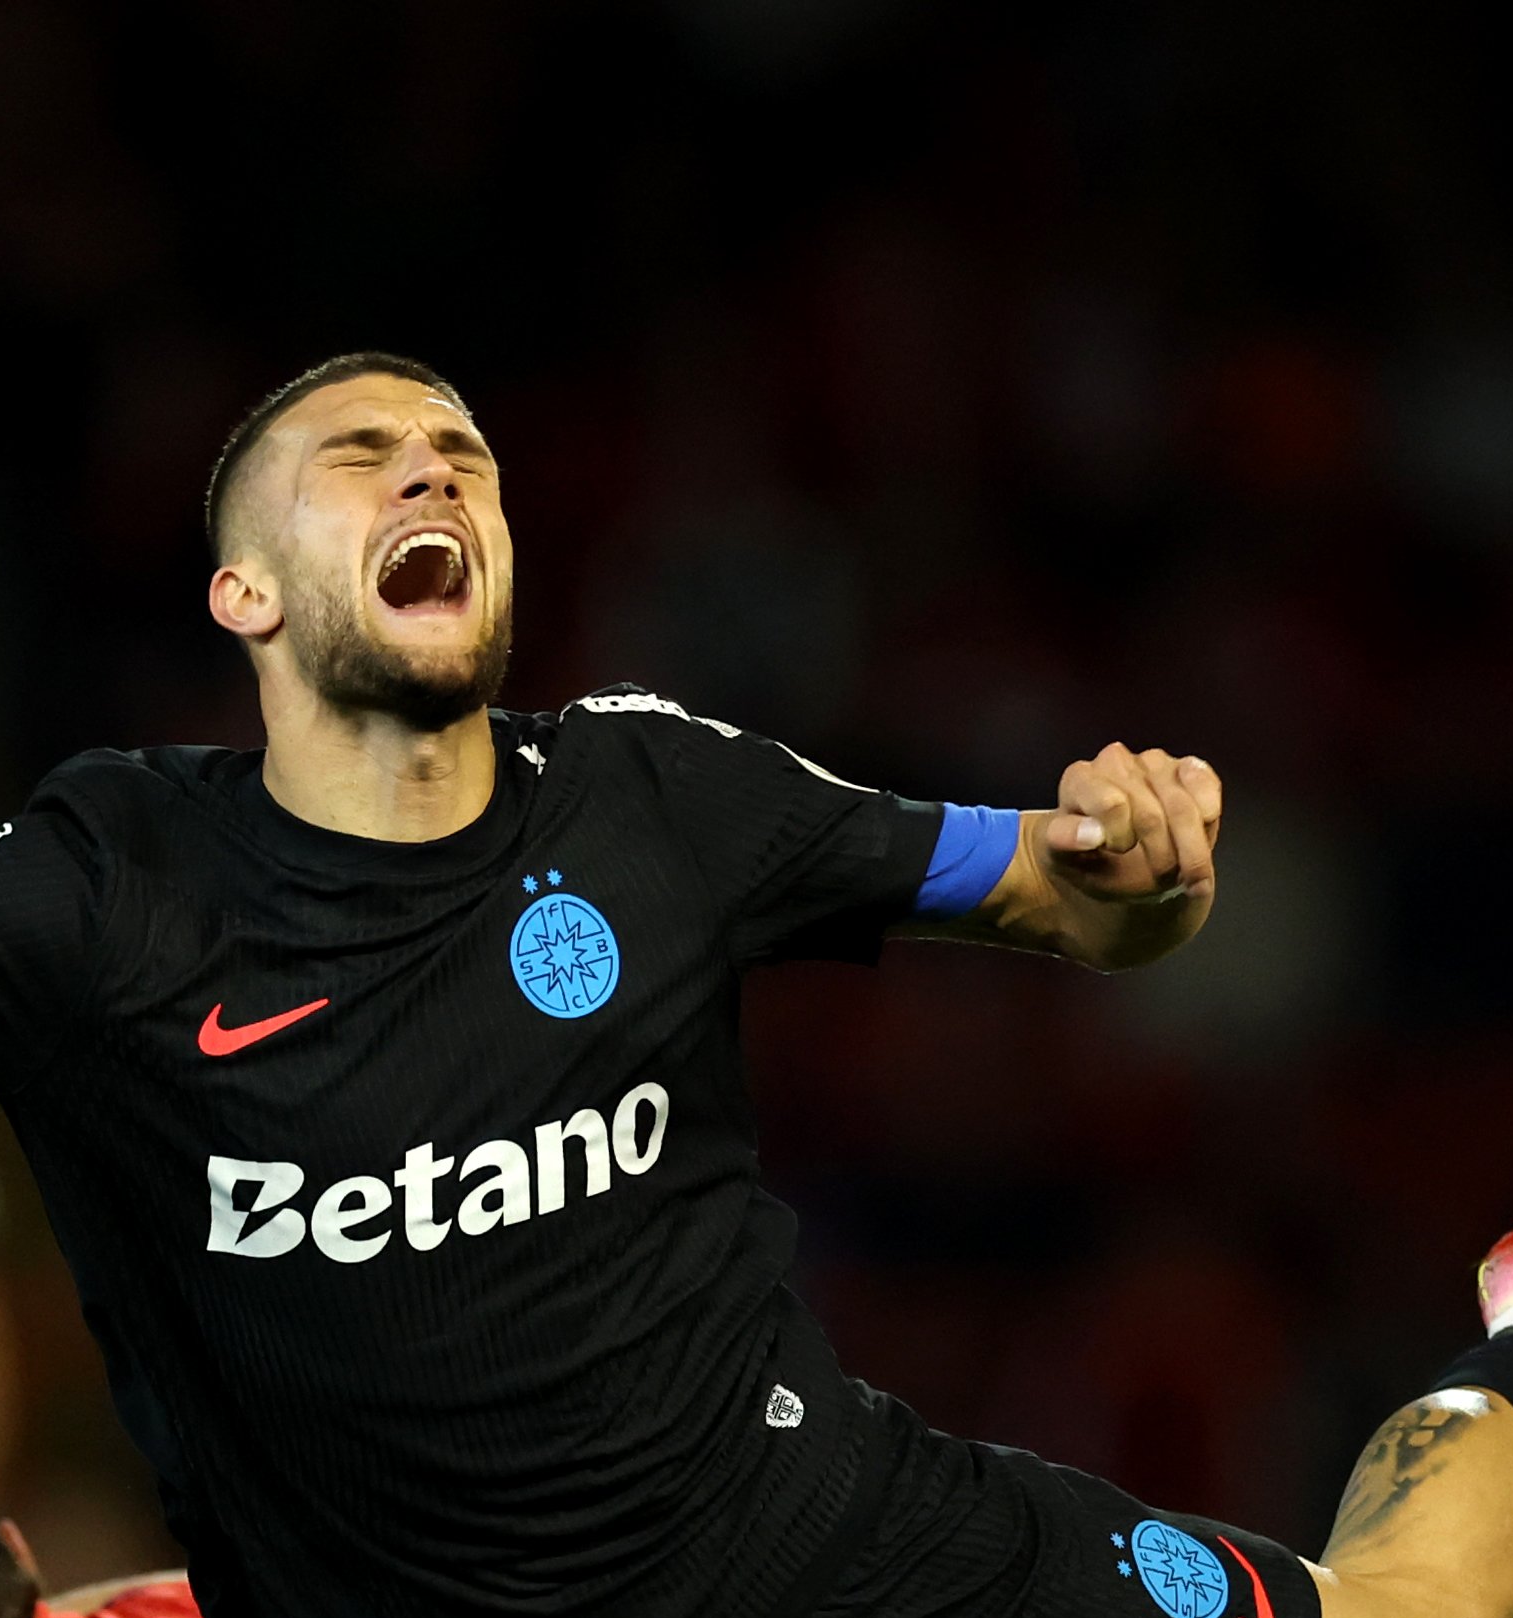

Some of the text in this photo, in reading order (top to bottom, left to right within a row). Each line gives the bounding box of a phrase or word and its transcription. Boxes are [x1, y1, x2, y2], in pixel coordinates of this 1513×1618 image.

[546, 902, 560, 918] F
[595, 938, 609, 954] B
[519, 960, 534, 976] S
[571, 994, 585, 1009] C
[206, 1082, 669, 1264] Betano
